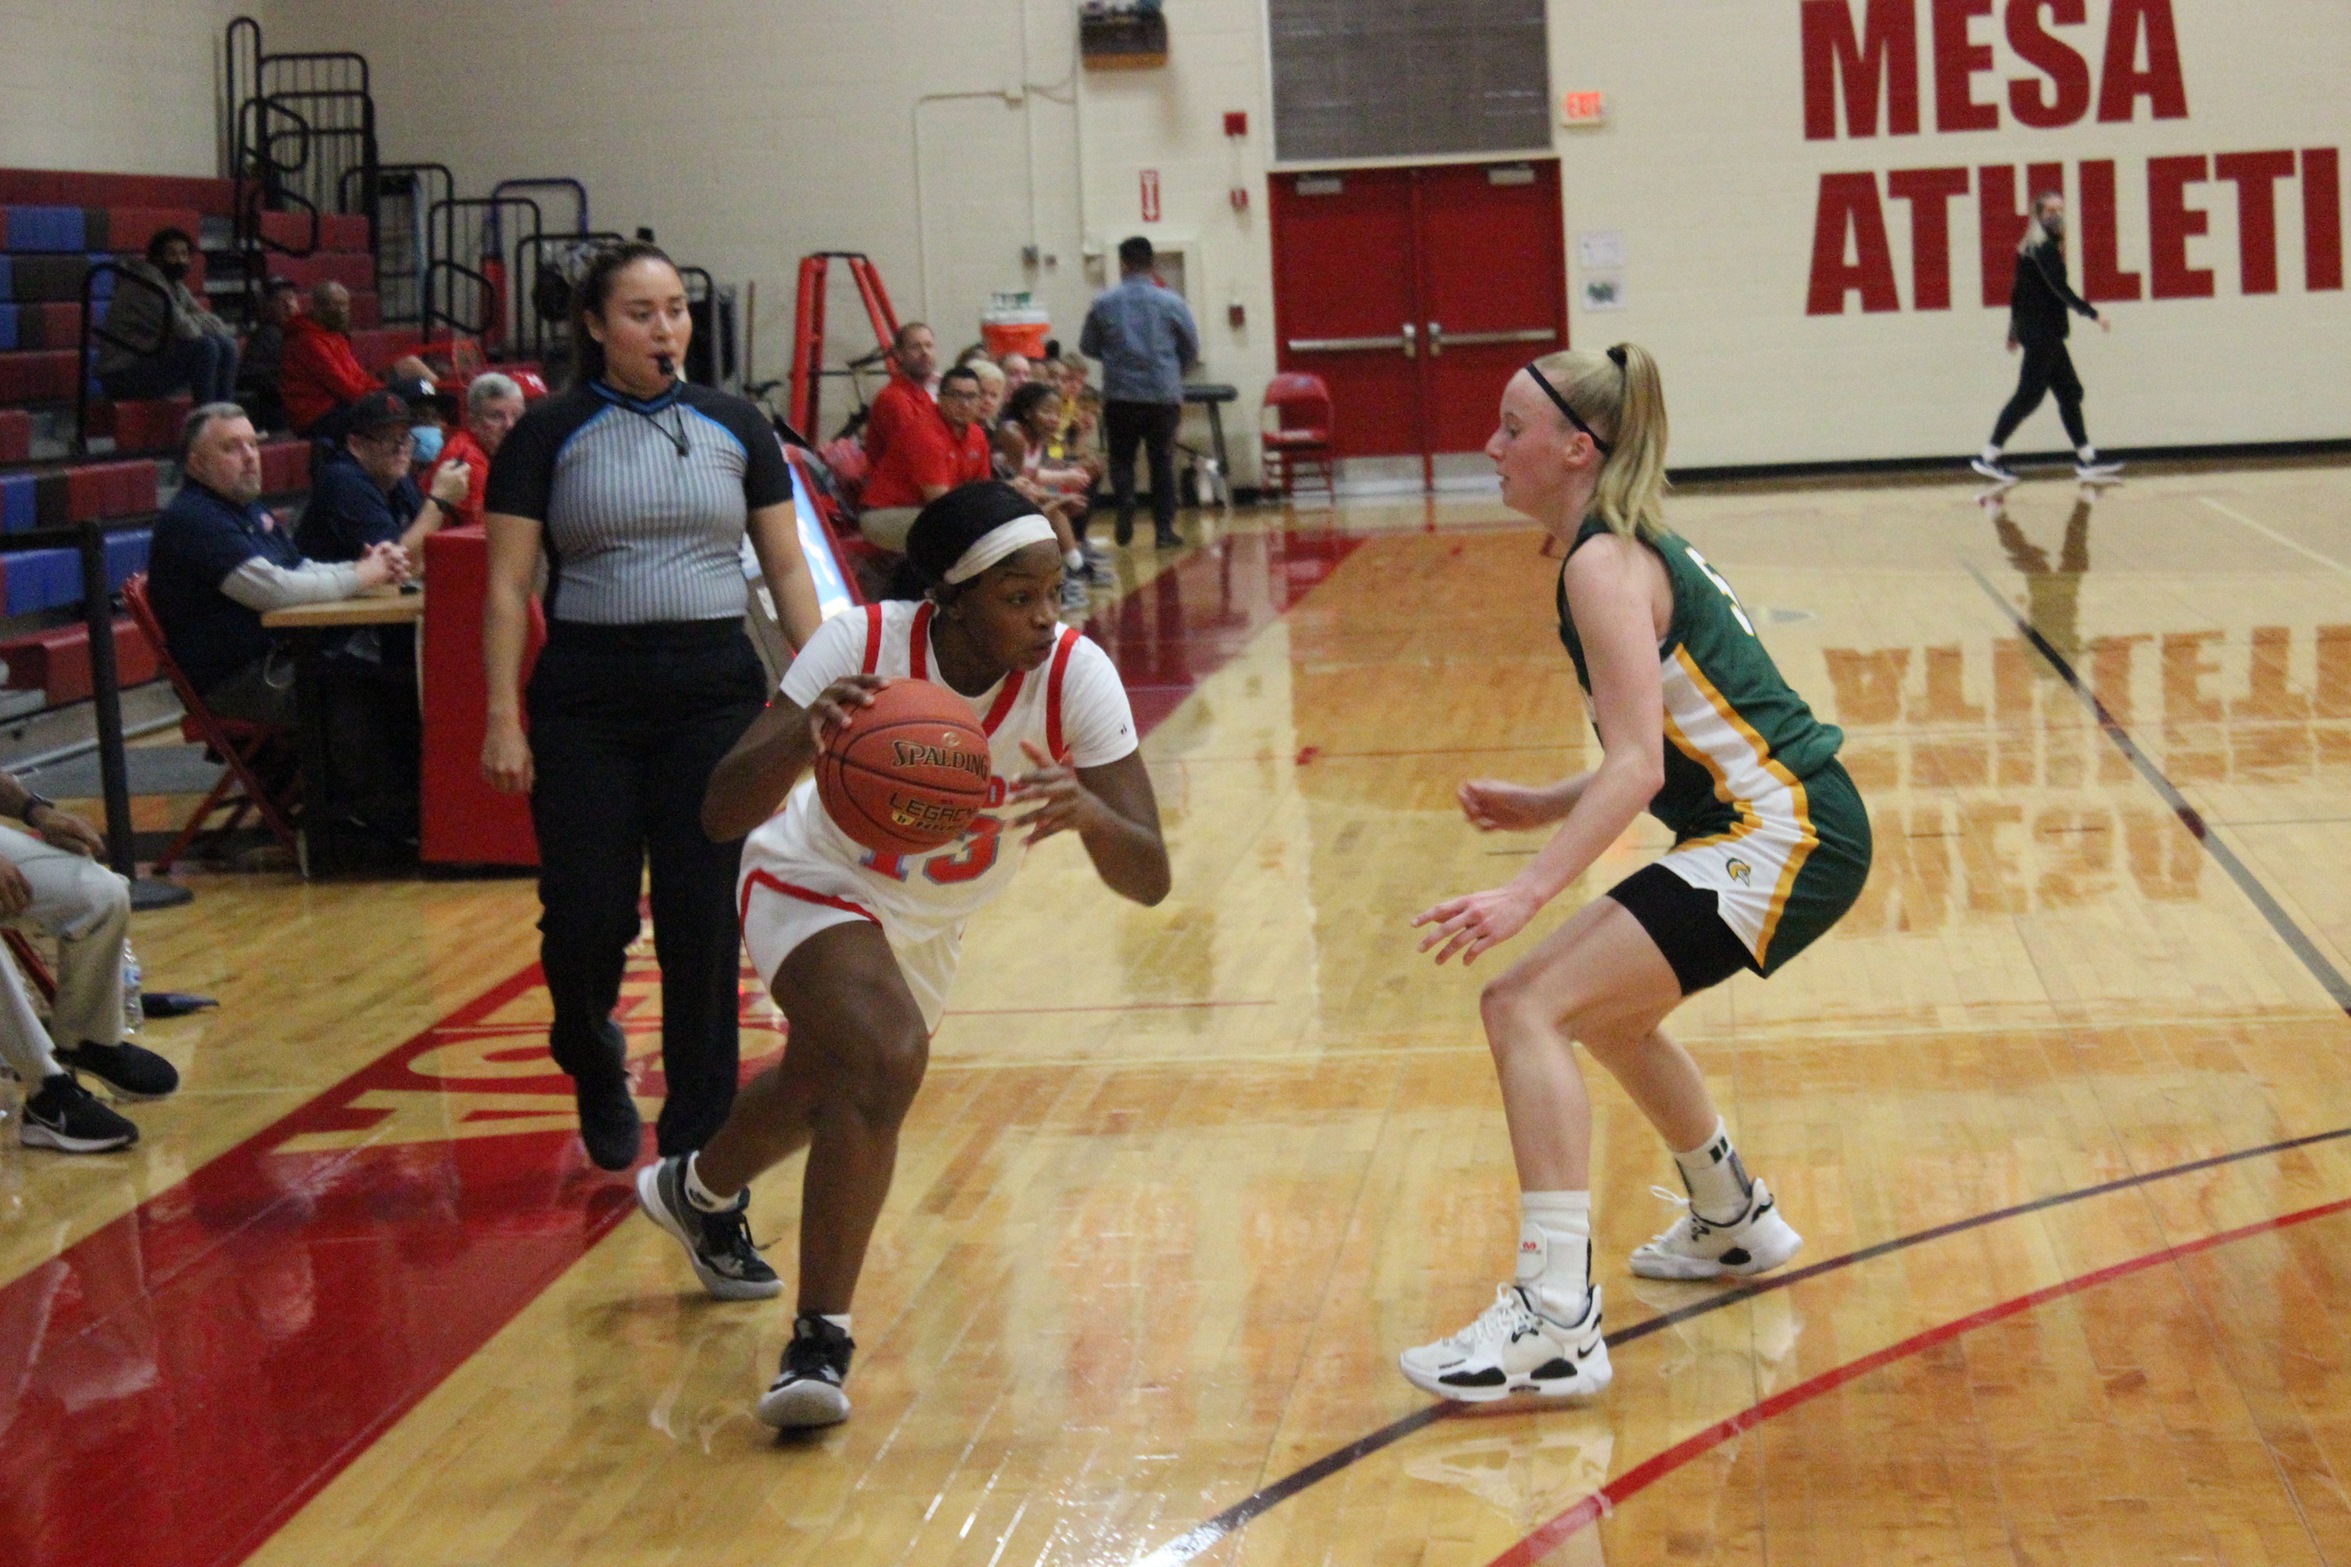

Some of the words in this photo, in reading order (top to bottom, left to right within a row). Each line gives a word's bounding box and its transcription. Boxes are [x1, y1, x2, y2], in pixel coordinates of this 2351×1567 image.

[1801, 0, 2188, 140] MESA
[1806, 147, 2343, 317] ATHLETI
[892, 739, 989, 781] SPALDING
